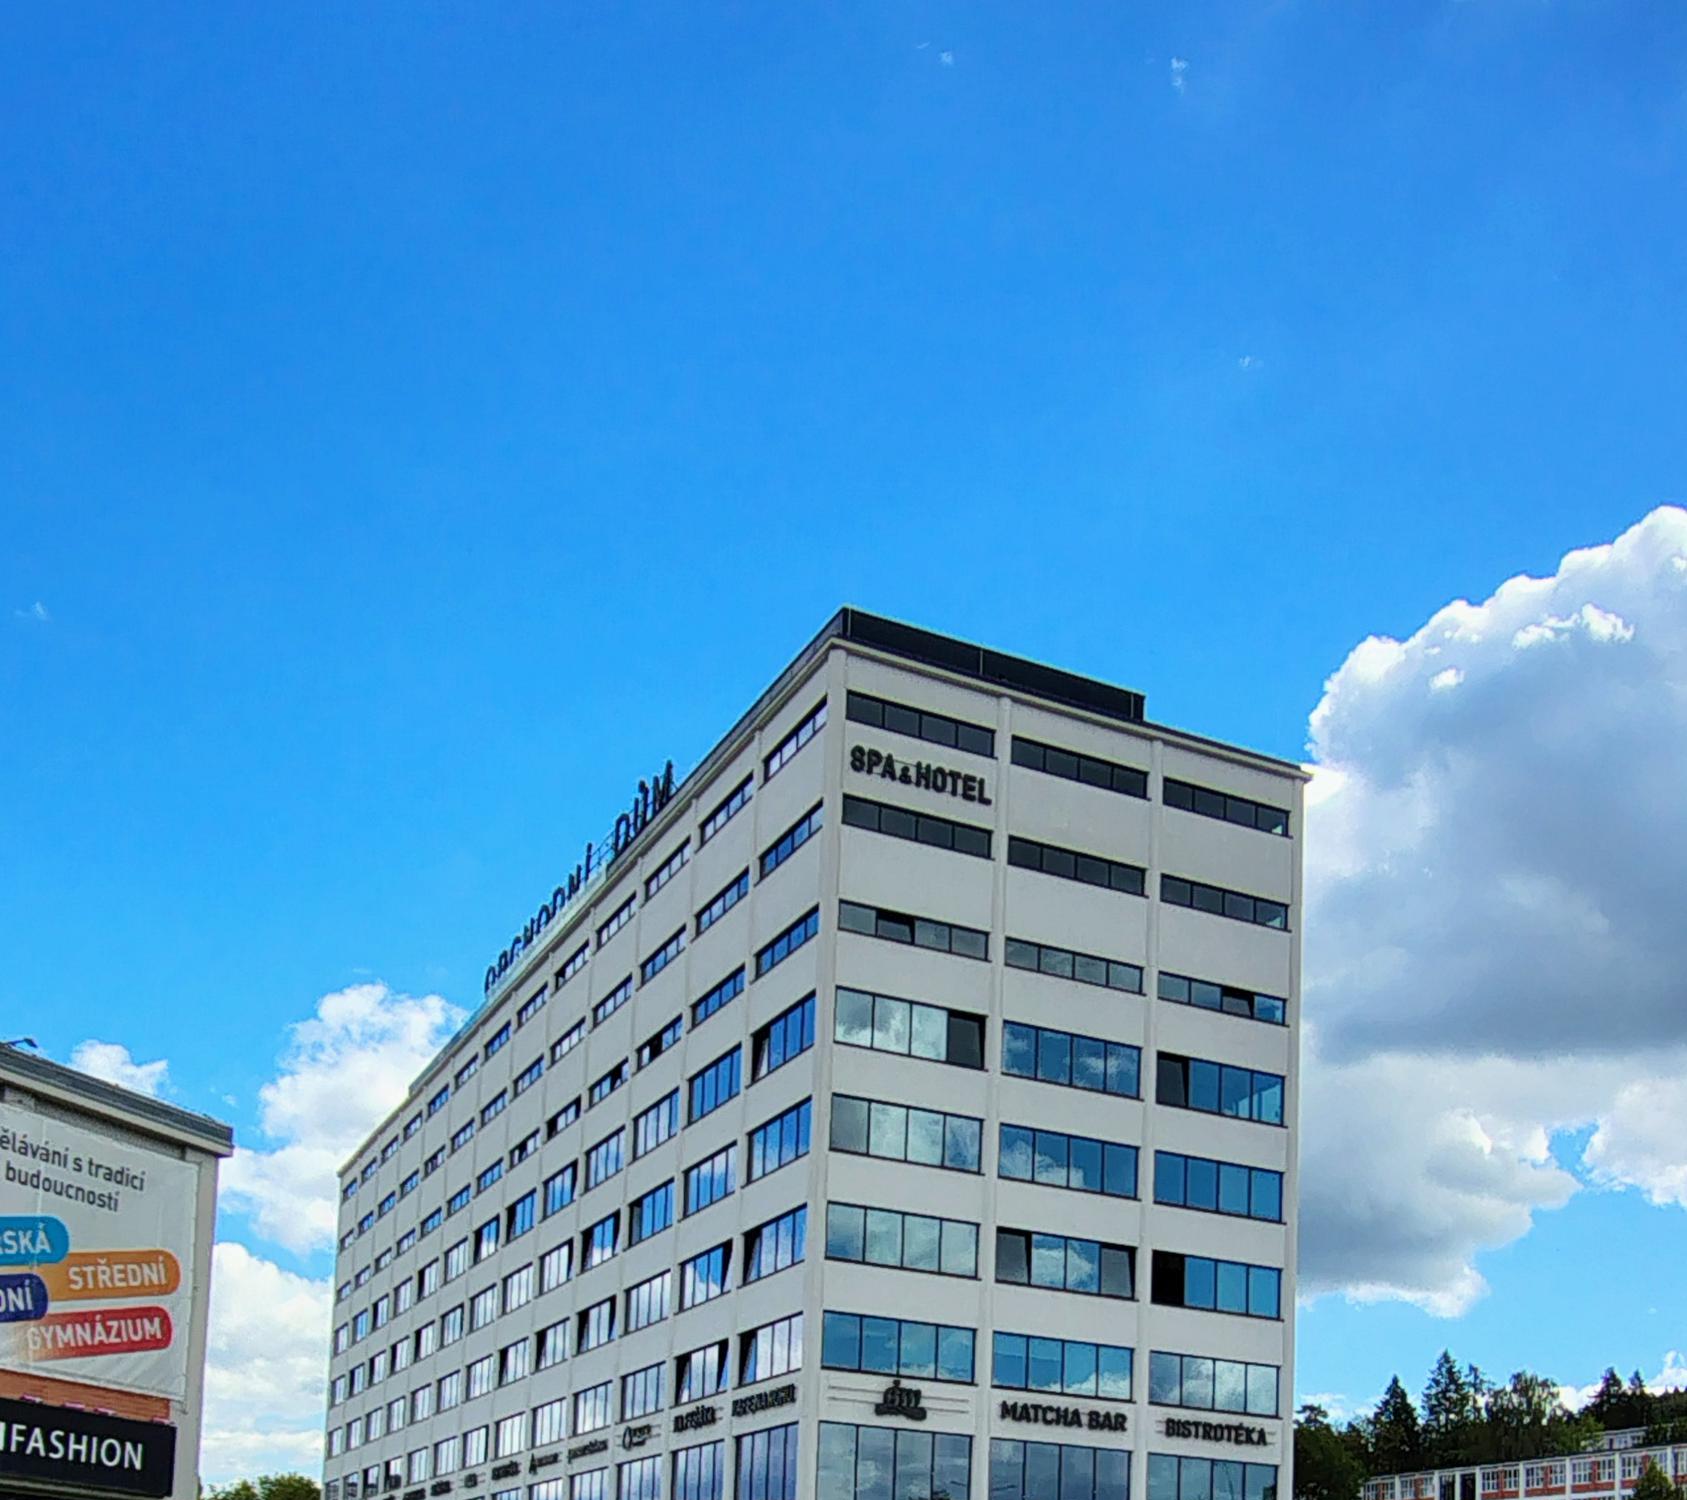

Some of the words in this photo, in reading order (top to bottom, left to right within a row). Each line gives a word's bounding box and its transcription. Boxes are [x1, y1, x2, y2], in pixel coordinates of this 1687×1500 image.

[73, 1155, 83, 1173] s
[88, 1157, 147, 1192] tradicí
[0, 1222, 52, 1255] SKÁ
[68, 1257, 167, 1291] STŘEDNÍ
[27, 1315, 162, 1350] GYMNÁZIUM
[1001, 1400, 1082, 1428] MATCHA
[1087, 1410, 1127, 1432] BAR
[1165, 1418, 1268, 1446] BISTROTÉKA
